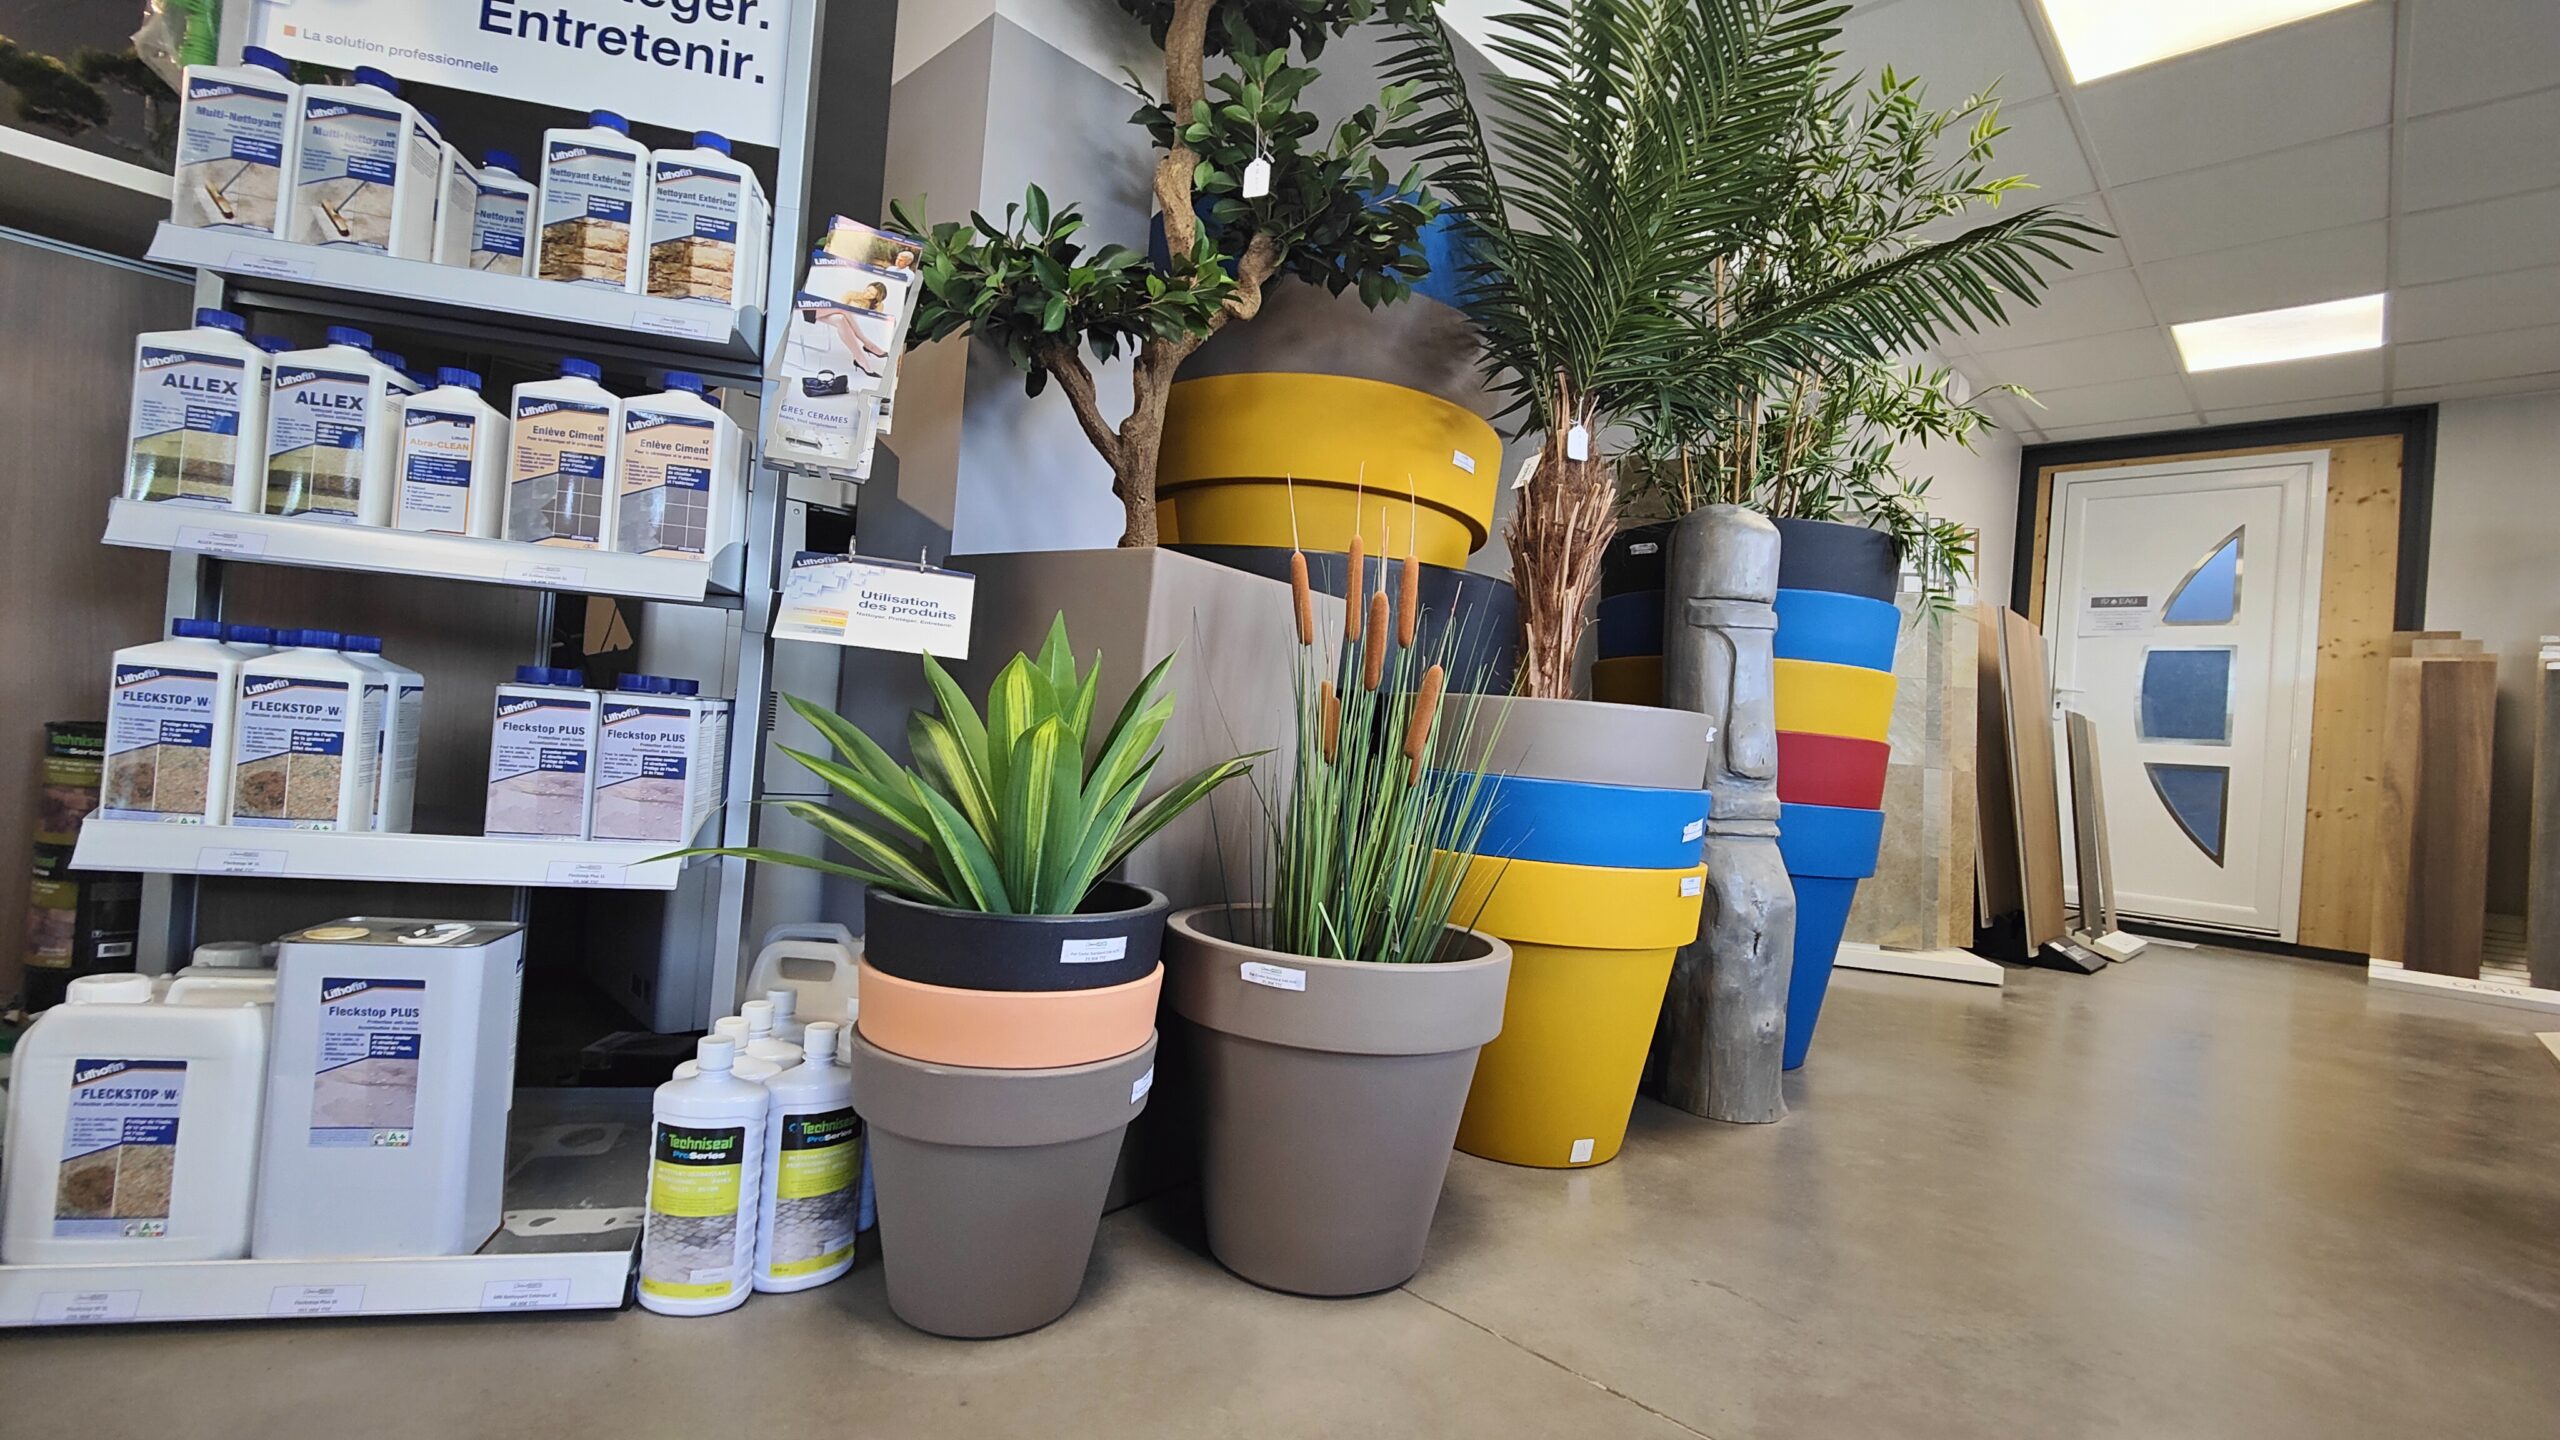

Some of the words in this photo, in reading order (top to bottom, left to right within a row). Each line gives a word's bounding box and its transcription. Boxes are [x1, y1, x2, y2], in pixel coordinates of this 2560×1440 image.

[623, 0, 768, 30] ger.
[478, 0, 764, 84] Entretenir.
[303, 28, 320, 41] La
[326, 32, 384, 53] solution
[388, 44, 499, 73] professionnelle
[190, 86, 234, 99] Lithofin
[196, 106, 282, 129] Multi-Nettoyant
[307, 106, 349, 119] Lithofin
[312, 125, 396, 148] Multi-Nettoyant
[550, 148, 587, 162] Lithofin
[550, 167, 590, 180] Nettoyant
[592, 173, 631, 187] Extérieur
[657, 168, 693, 181] Lithofin
[657, 187, 697, 200] Nettoyant
[699, 194, 737, 207] Extérieur
[476, 209, 524, 225] -Nettoyant
[798, 300, 831, 308] Lithofin
[142, 353, 186, 369] Lithofin
[162, 373, 238, 396] ALLEX
[277, 371, 316, 387] Lithofin
[295, 390, 364, 411] ALLEX
[519, 402, 558, 417] Lithofin
[780, 404, 804, 416] GRES
[807, 408, 849, 424] CERAMES
[407, 414, 436, 426] Lithofin
[628, 416, 665, 431] Lithofin
[532, 425, 566, 438] Enlève
[569, 430, 604, 442] Ciment
[410, 438, 469, 451] Abra-CLEAN
[640, 439, 672, 451] Enlève
[675, 442, 709, 455] Ciment
[796, 556, 840, 567] Lithofin
[861, 590, 939, 608] Utilisation
[859, 601, 887, 611] des
[892, 606, 957, 620] produits
[117, 669, 160, 686] Lithofin
[245, 679, 289, 696] Lithofin
[122, 691, 192, 706] FLECKSTOP
[251, 701, 323, 716] FLECKSTOP
[499, 700, 537, 715] Lithofin
[603, 707, 640, 724] Lithofin
[502, 721, 555, 734] Fleckstop
[559, 726, 585, 736] PLUS
[607, 729, 656, 742] Fleckstop
[660, 733, 685, 743] PLUS
[324, 980, 368, 1000] Lithofin
[329, 1006, 386, 1018] Fleckstop
[391, 1008, 420, 1018] PLUS
[76, 1062, 126, 1083] Lithofin
[80, 1088, 159, 1100] FLECKSTOP
[669, 1133, 734, 1150] Techniseal
[672, 1151, 726, 1160] ProSeries
